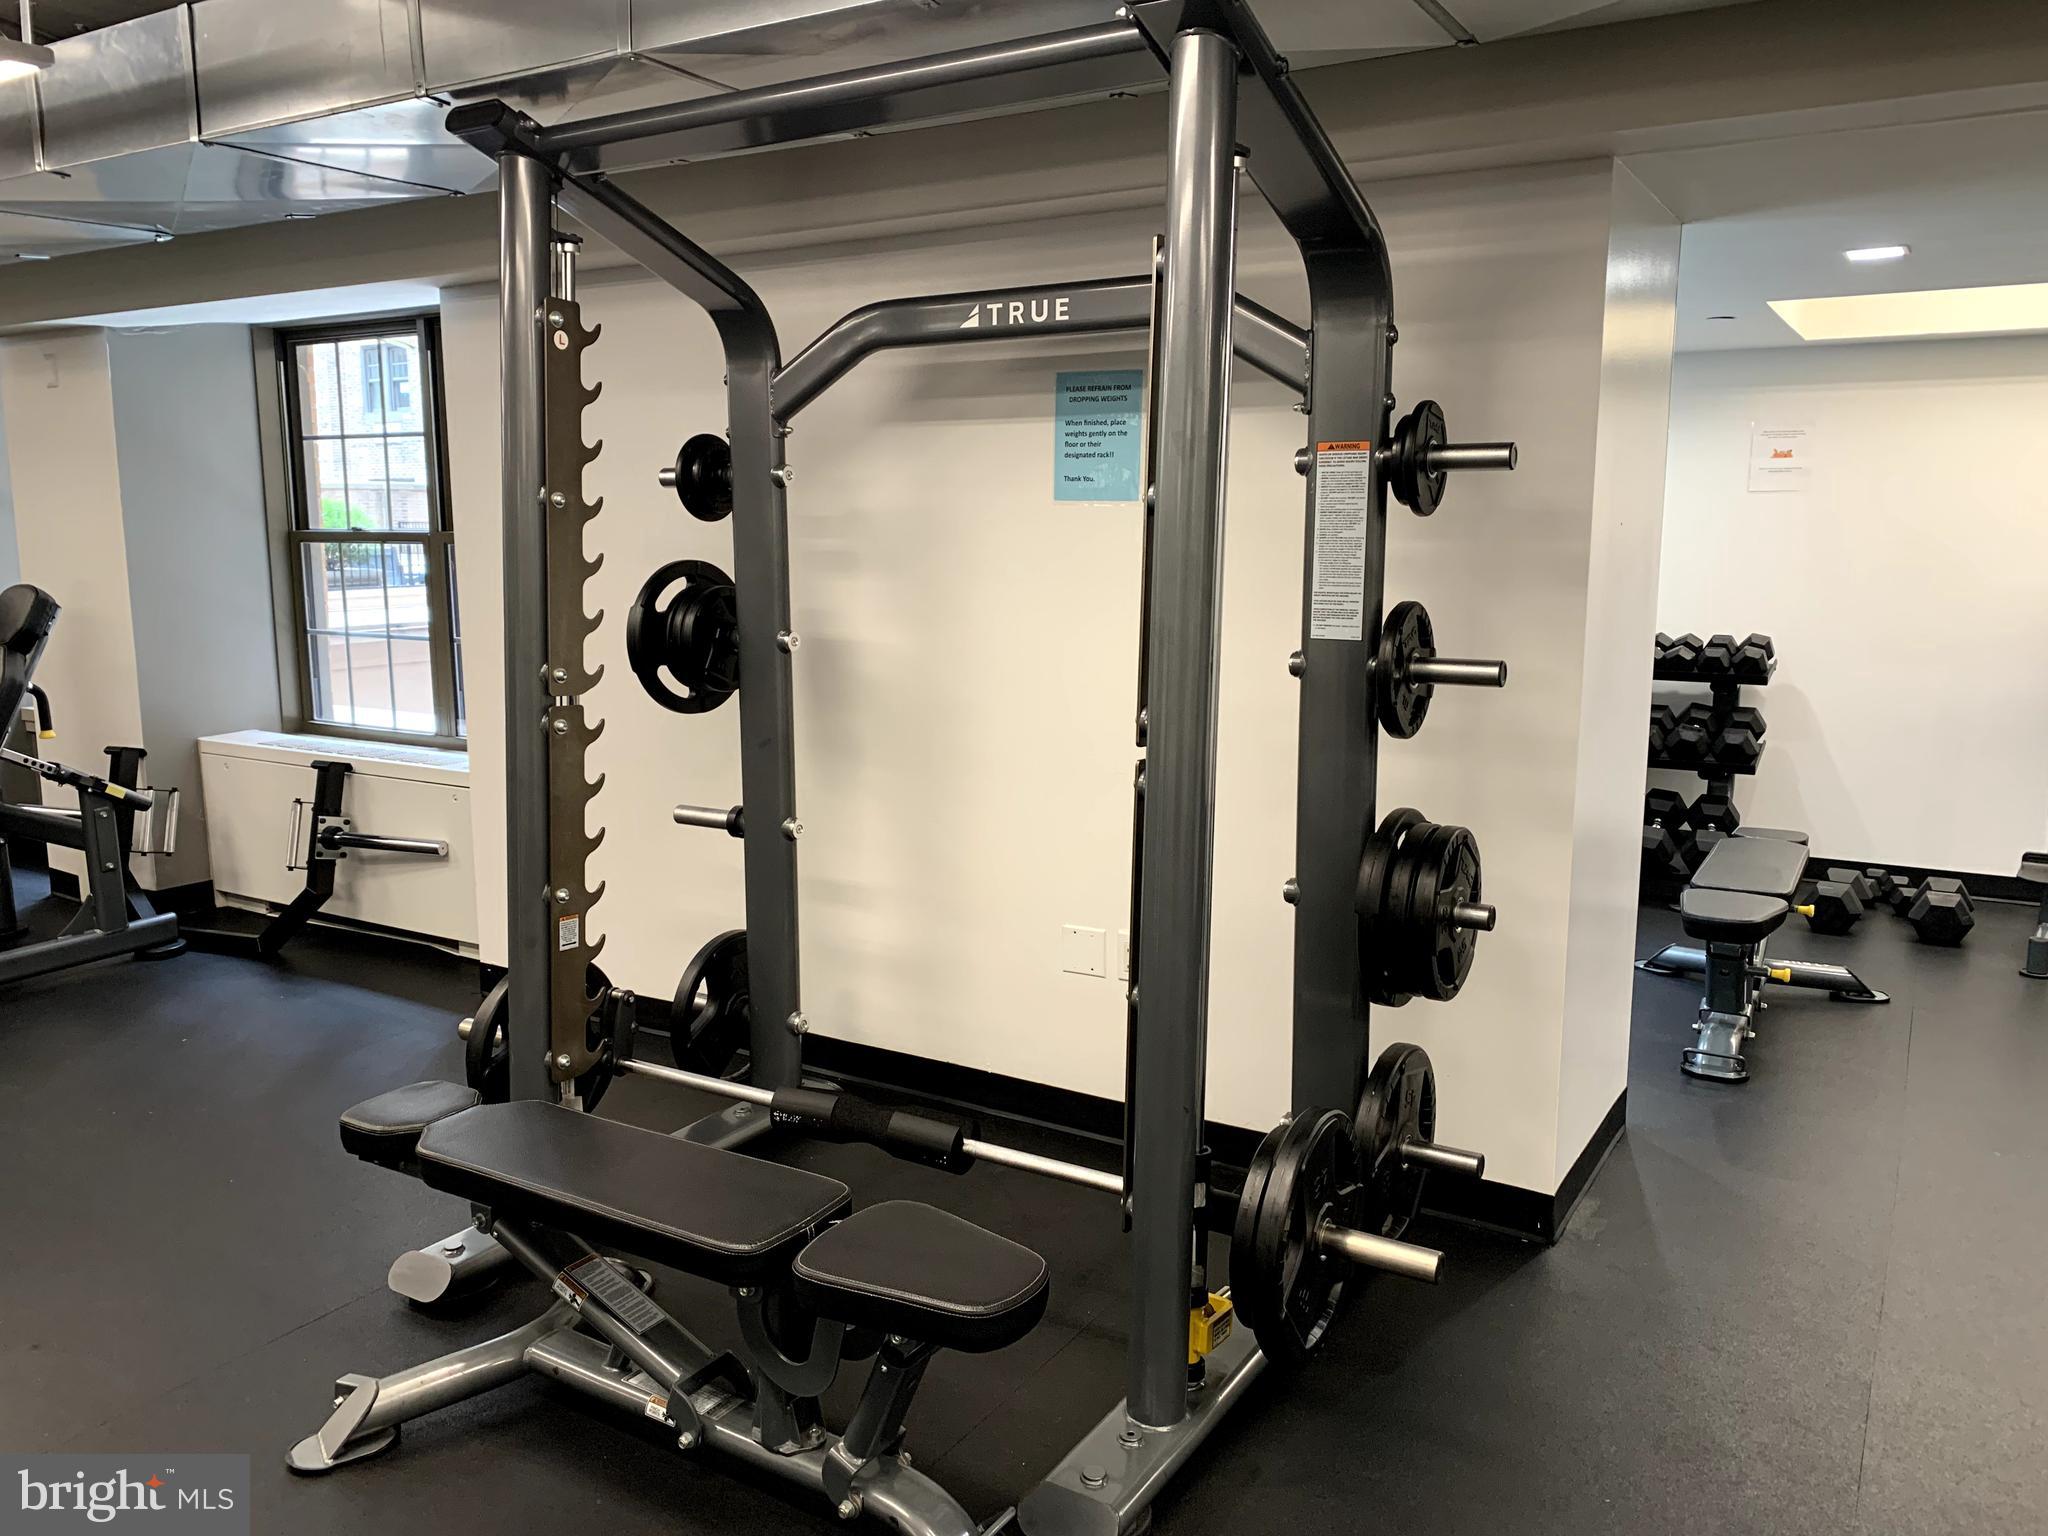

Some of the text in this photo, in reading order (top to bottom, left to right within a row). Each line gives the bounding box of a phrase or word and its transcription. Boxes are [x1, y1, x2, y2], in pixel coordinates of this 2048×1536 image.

[986, 298, 1070, 326] TRUE
[1065, 385, 1086, 393] PLEASE
[1083, 419, 1109, 427] finished,
[1110, 419, 1127, 427] place
[1064, 430, 1088, 438] weights
[1088, 430, 1107, 438] gently
[1064, 451, 1096, 459] designated
